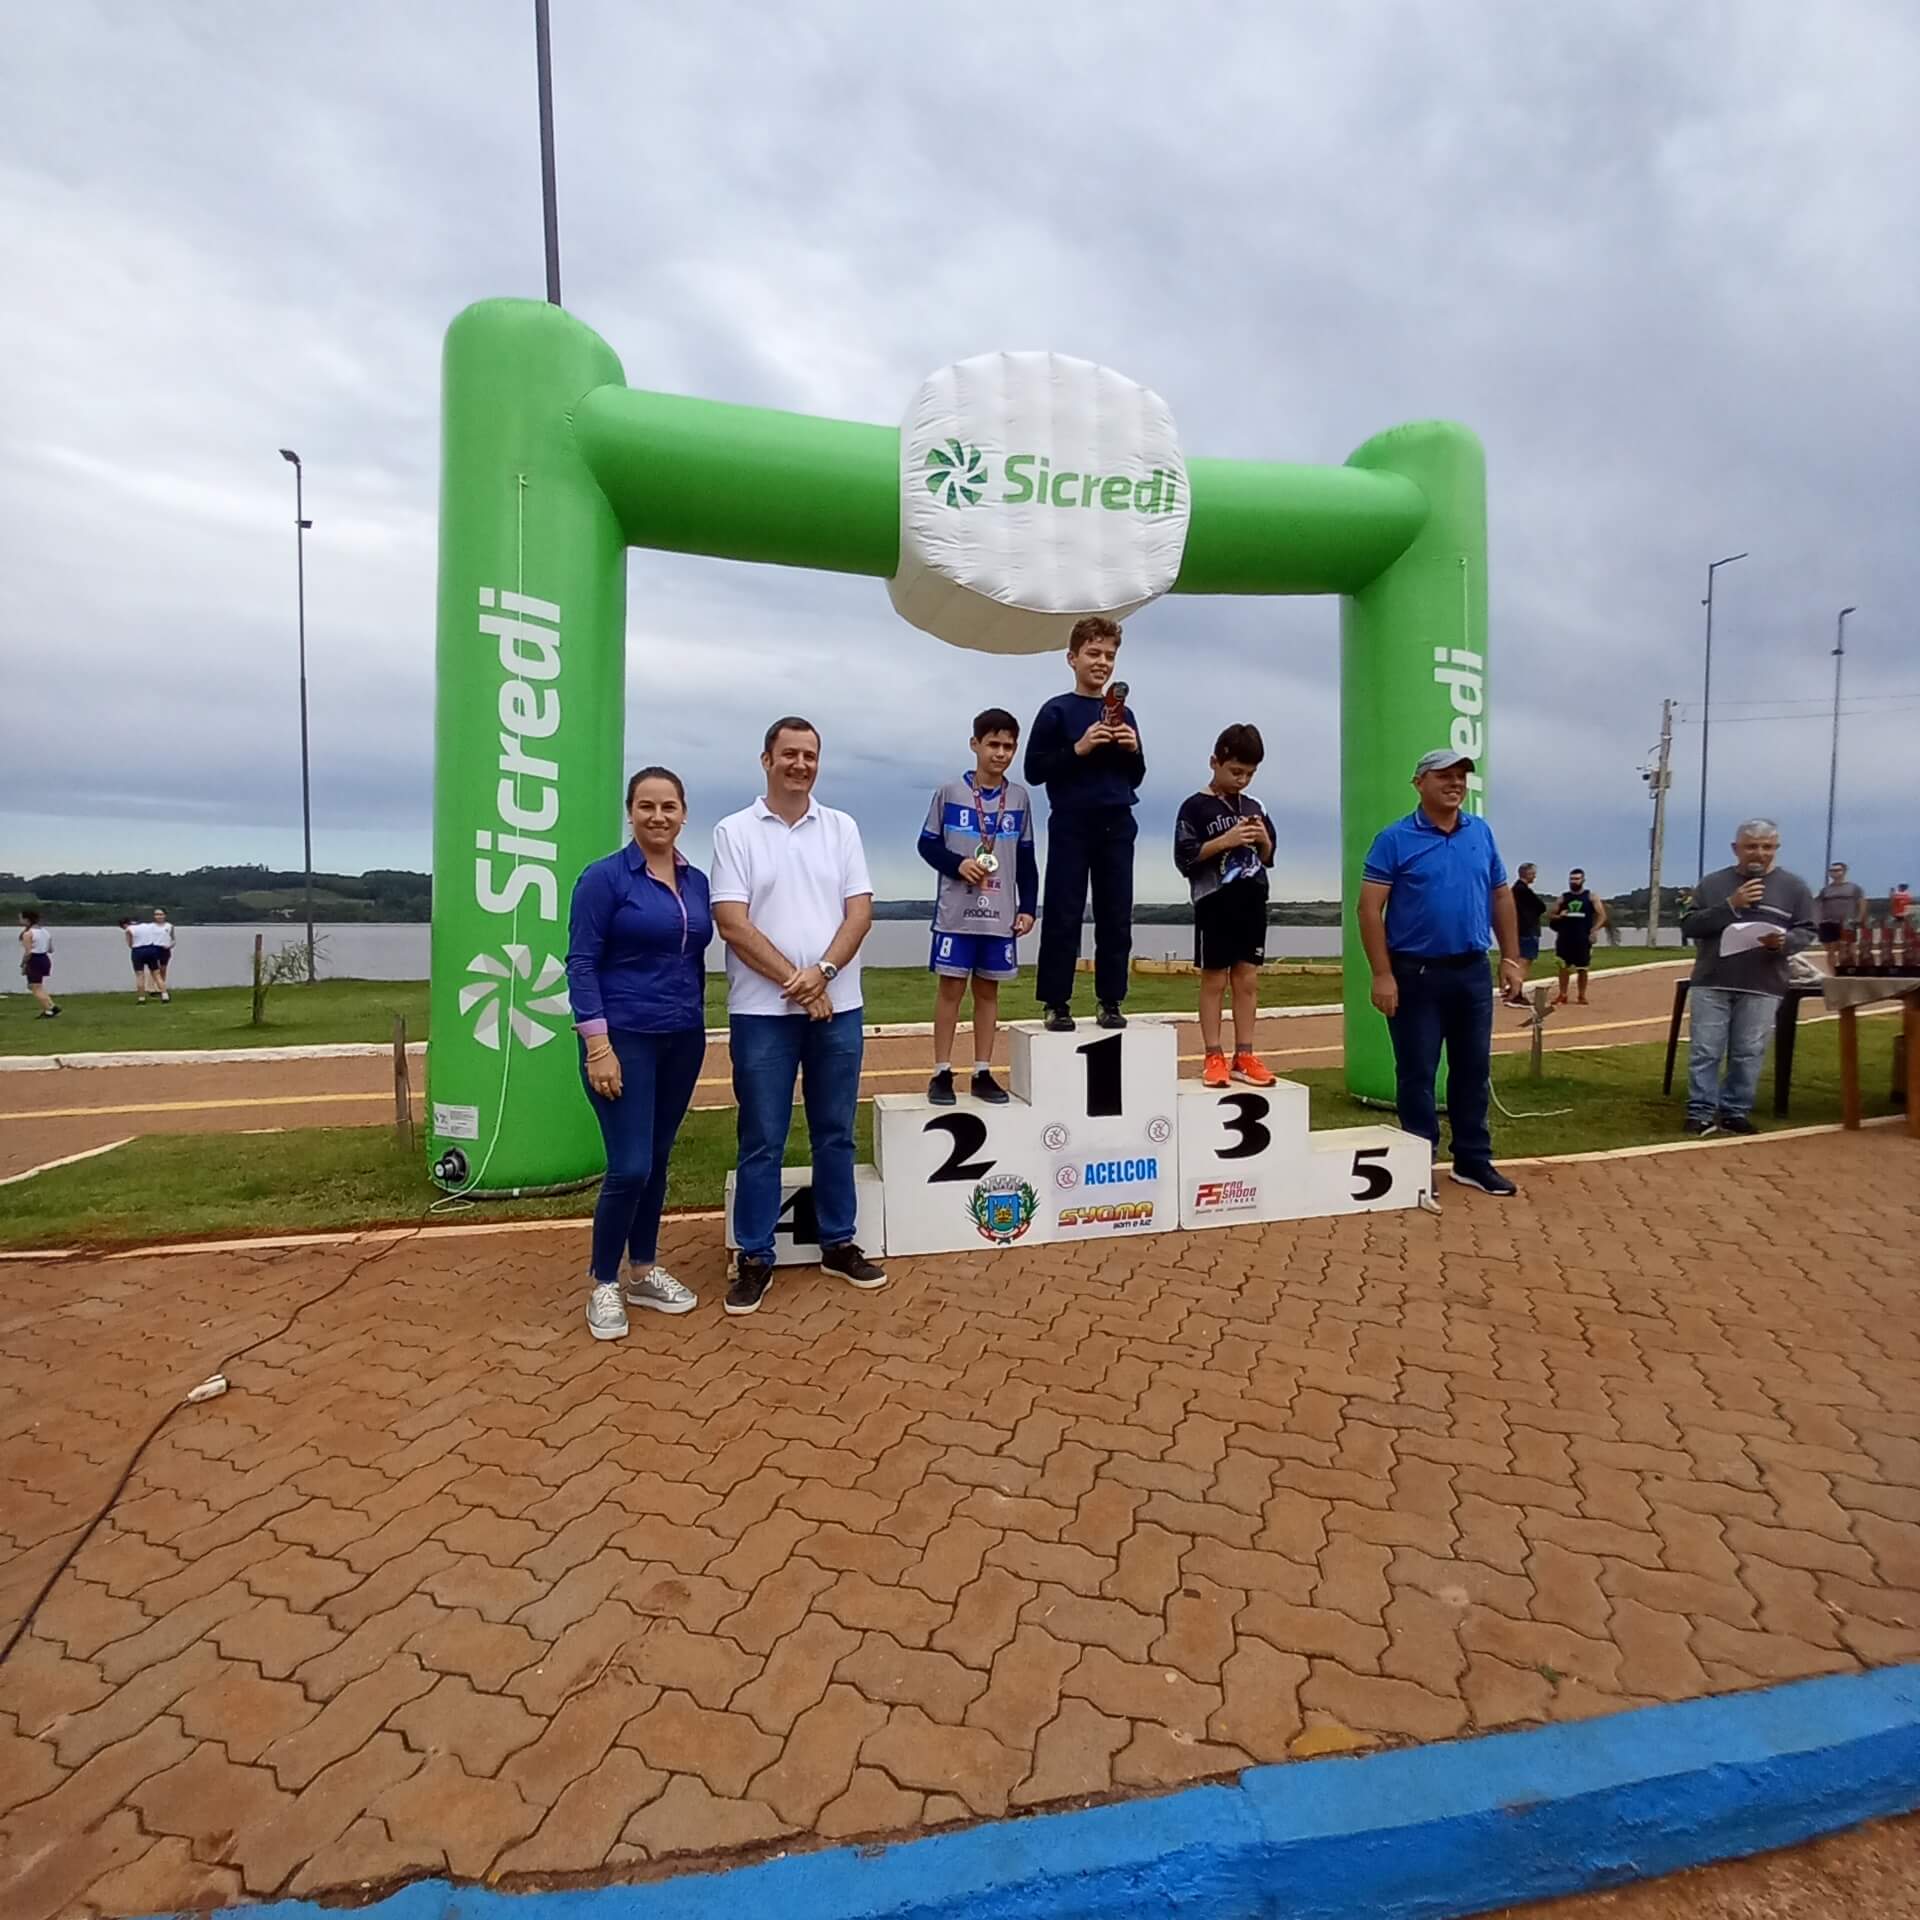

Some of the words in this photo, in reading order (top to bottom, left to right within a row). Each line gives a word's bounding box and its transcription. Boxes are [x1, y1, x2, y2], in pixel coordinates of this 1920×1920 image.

[1003, 454, 1177, 514] Sicredi
[475, 586, 561, 921] Sicredi
[960, 809, 969, 827] 8
[940, 936, 952, 958] 8
[1075, 1032, 1122, 1117] 1
[923, 1112, 997, 1184] 2
[1214, 1093, 1271, 1159] 3
[1085, 1158, 1157, 1185] ACELCOR
[1351, 1147, 1393, 1201] 5
